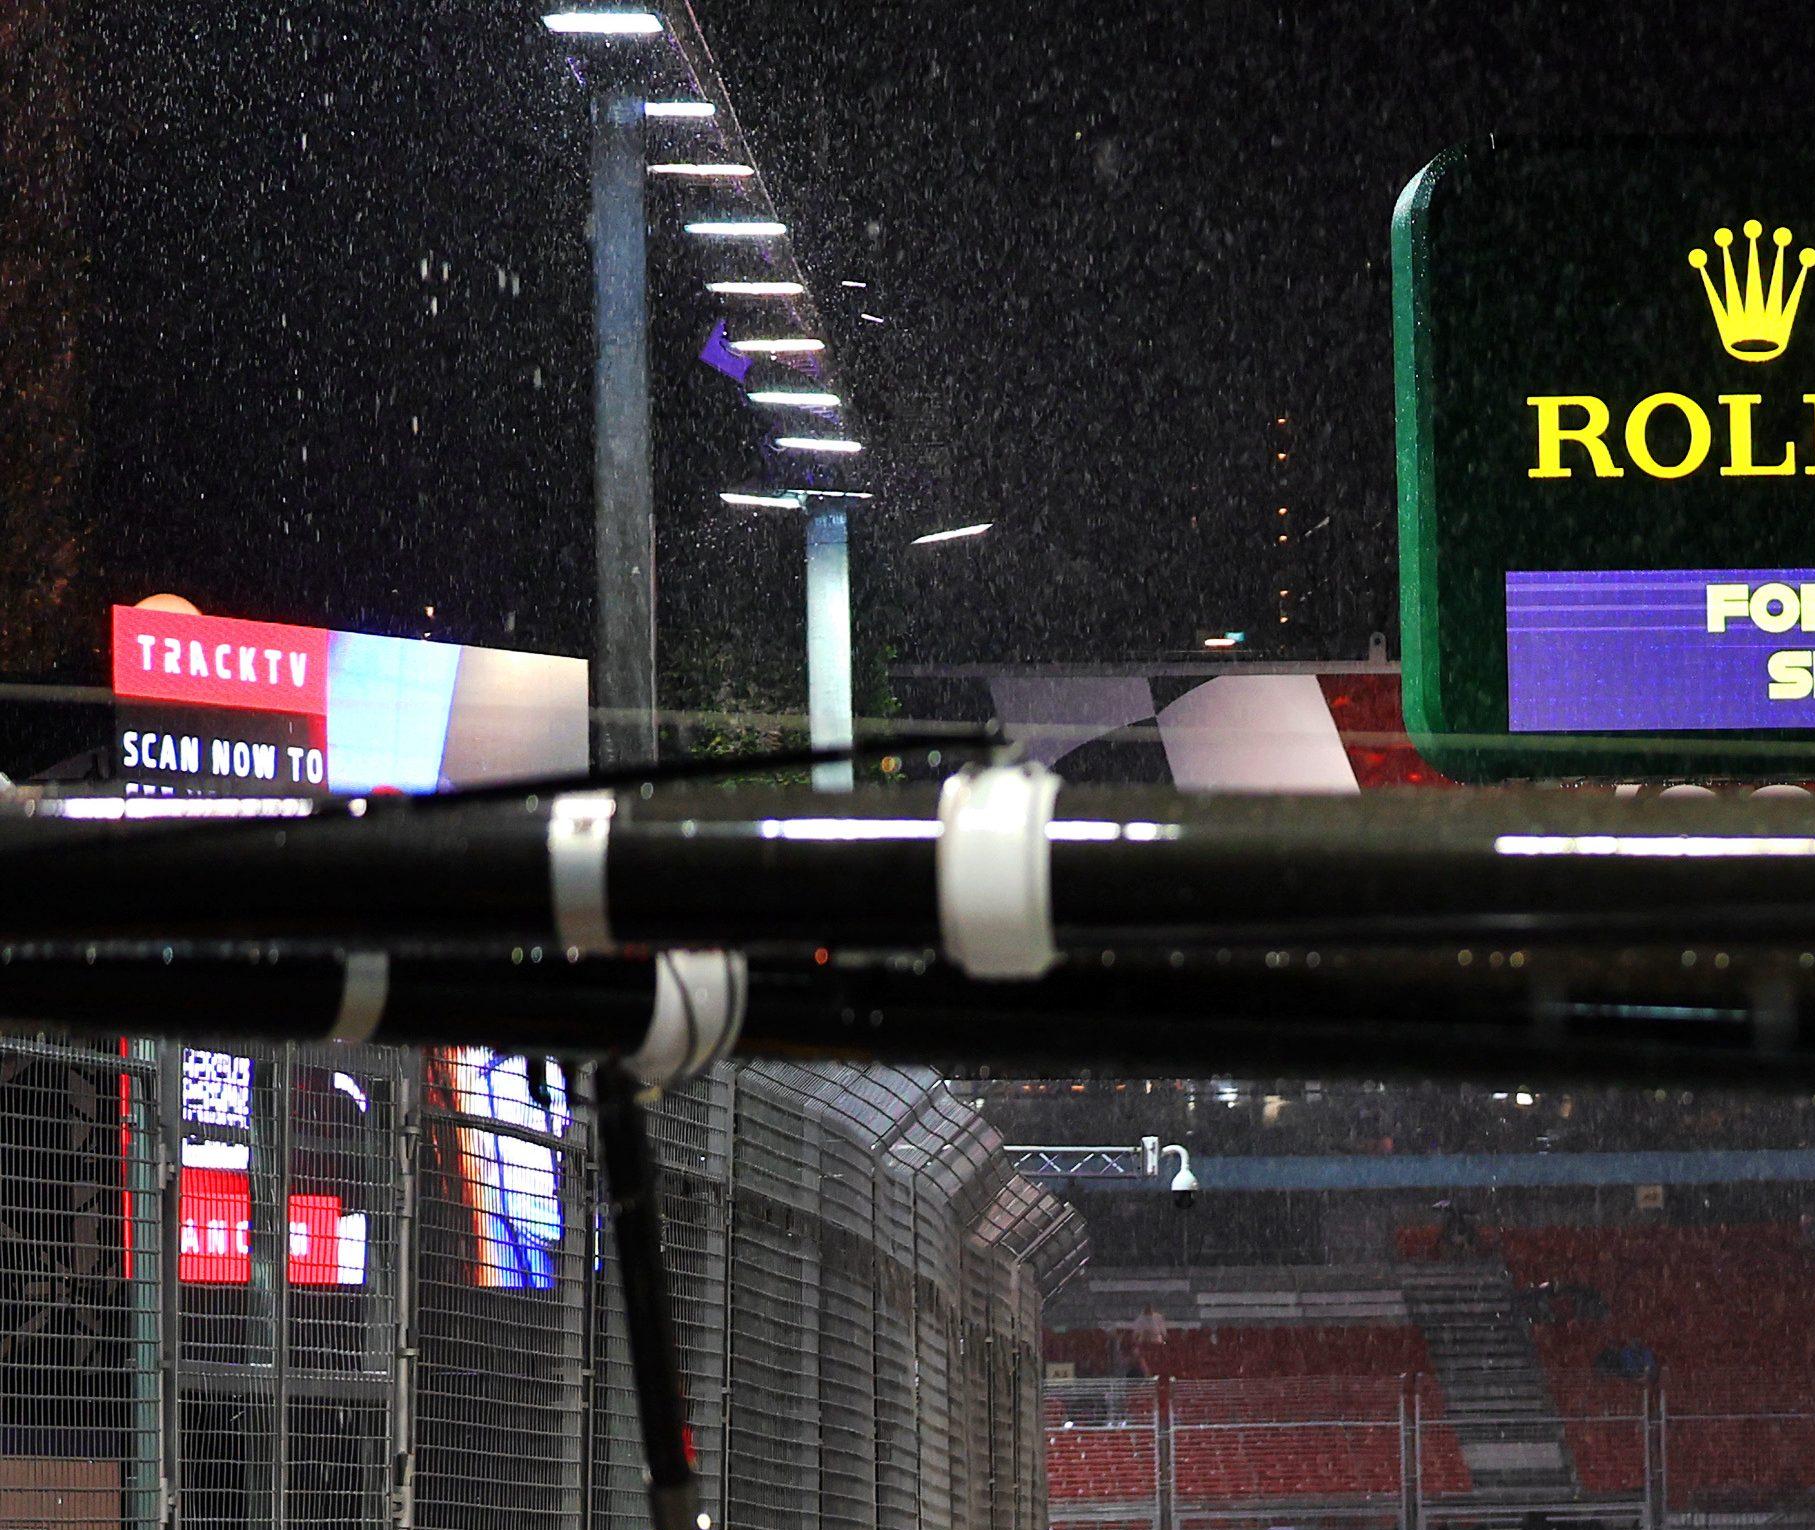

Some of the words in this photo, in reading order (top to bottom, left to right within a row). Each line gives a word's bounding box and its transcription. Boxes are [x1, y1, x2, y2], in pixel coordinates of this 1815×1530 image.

[137, 634, 307, 687] TRACKTV
[123, 731, 199, 774] SCAN
[211, 738, 276, 781] NOW
[287, 746, 323, 785] TO
